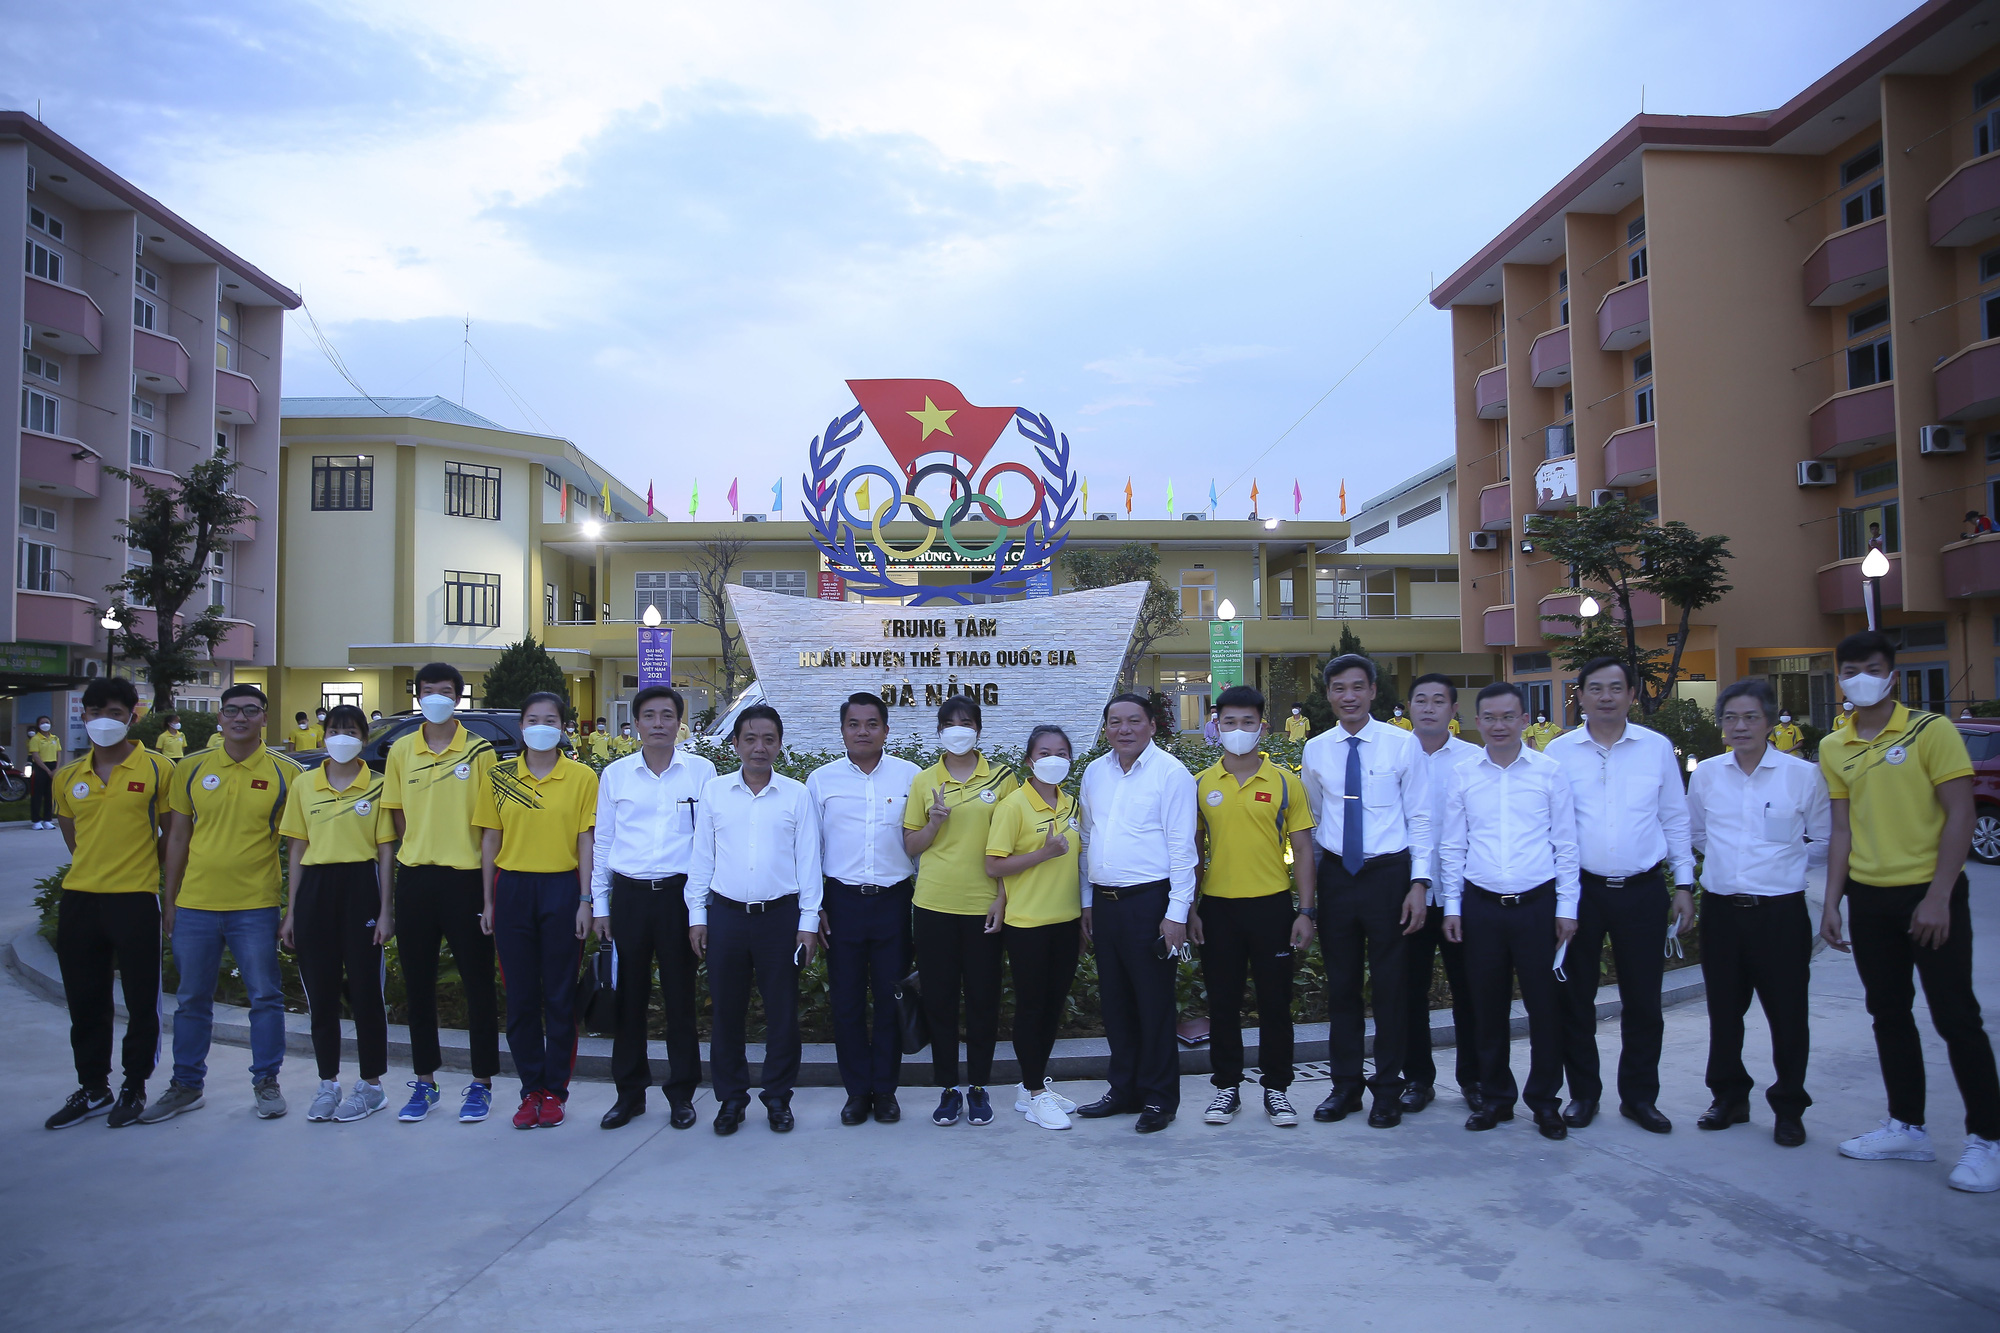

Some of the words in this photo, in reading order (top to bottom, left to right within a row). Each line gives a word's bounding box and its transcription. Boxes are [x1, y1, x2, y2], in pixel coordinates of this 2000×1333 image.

[882, 618, 946, 638] TRUNG
[954, 614, 996, 638] TÂM
[799, 646, 846, 667] HUẤN
[851, 648, 904, 672] LUYỆN
[910, 642, 941, 667] THỂ
[946, 650, 991, 666] THAO
[996, 644, 1042, 668] QUỐC
[1047, 650, 1077, 666] GIA
[881, 678, 917, 706] ĐÀ
